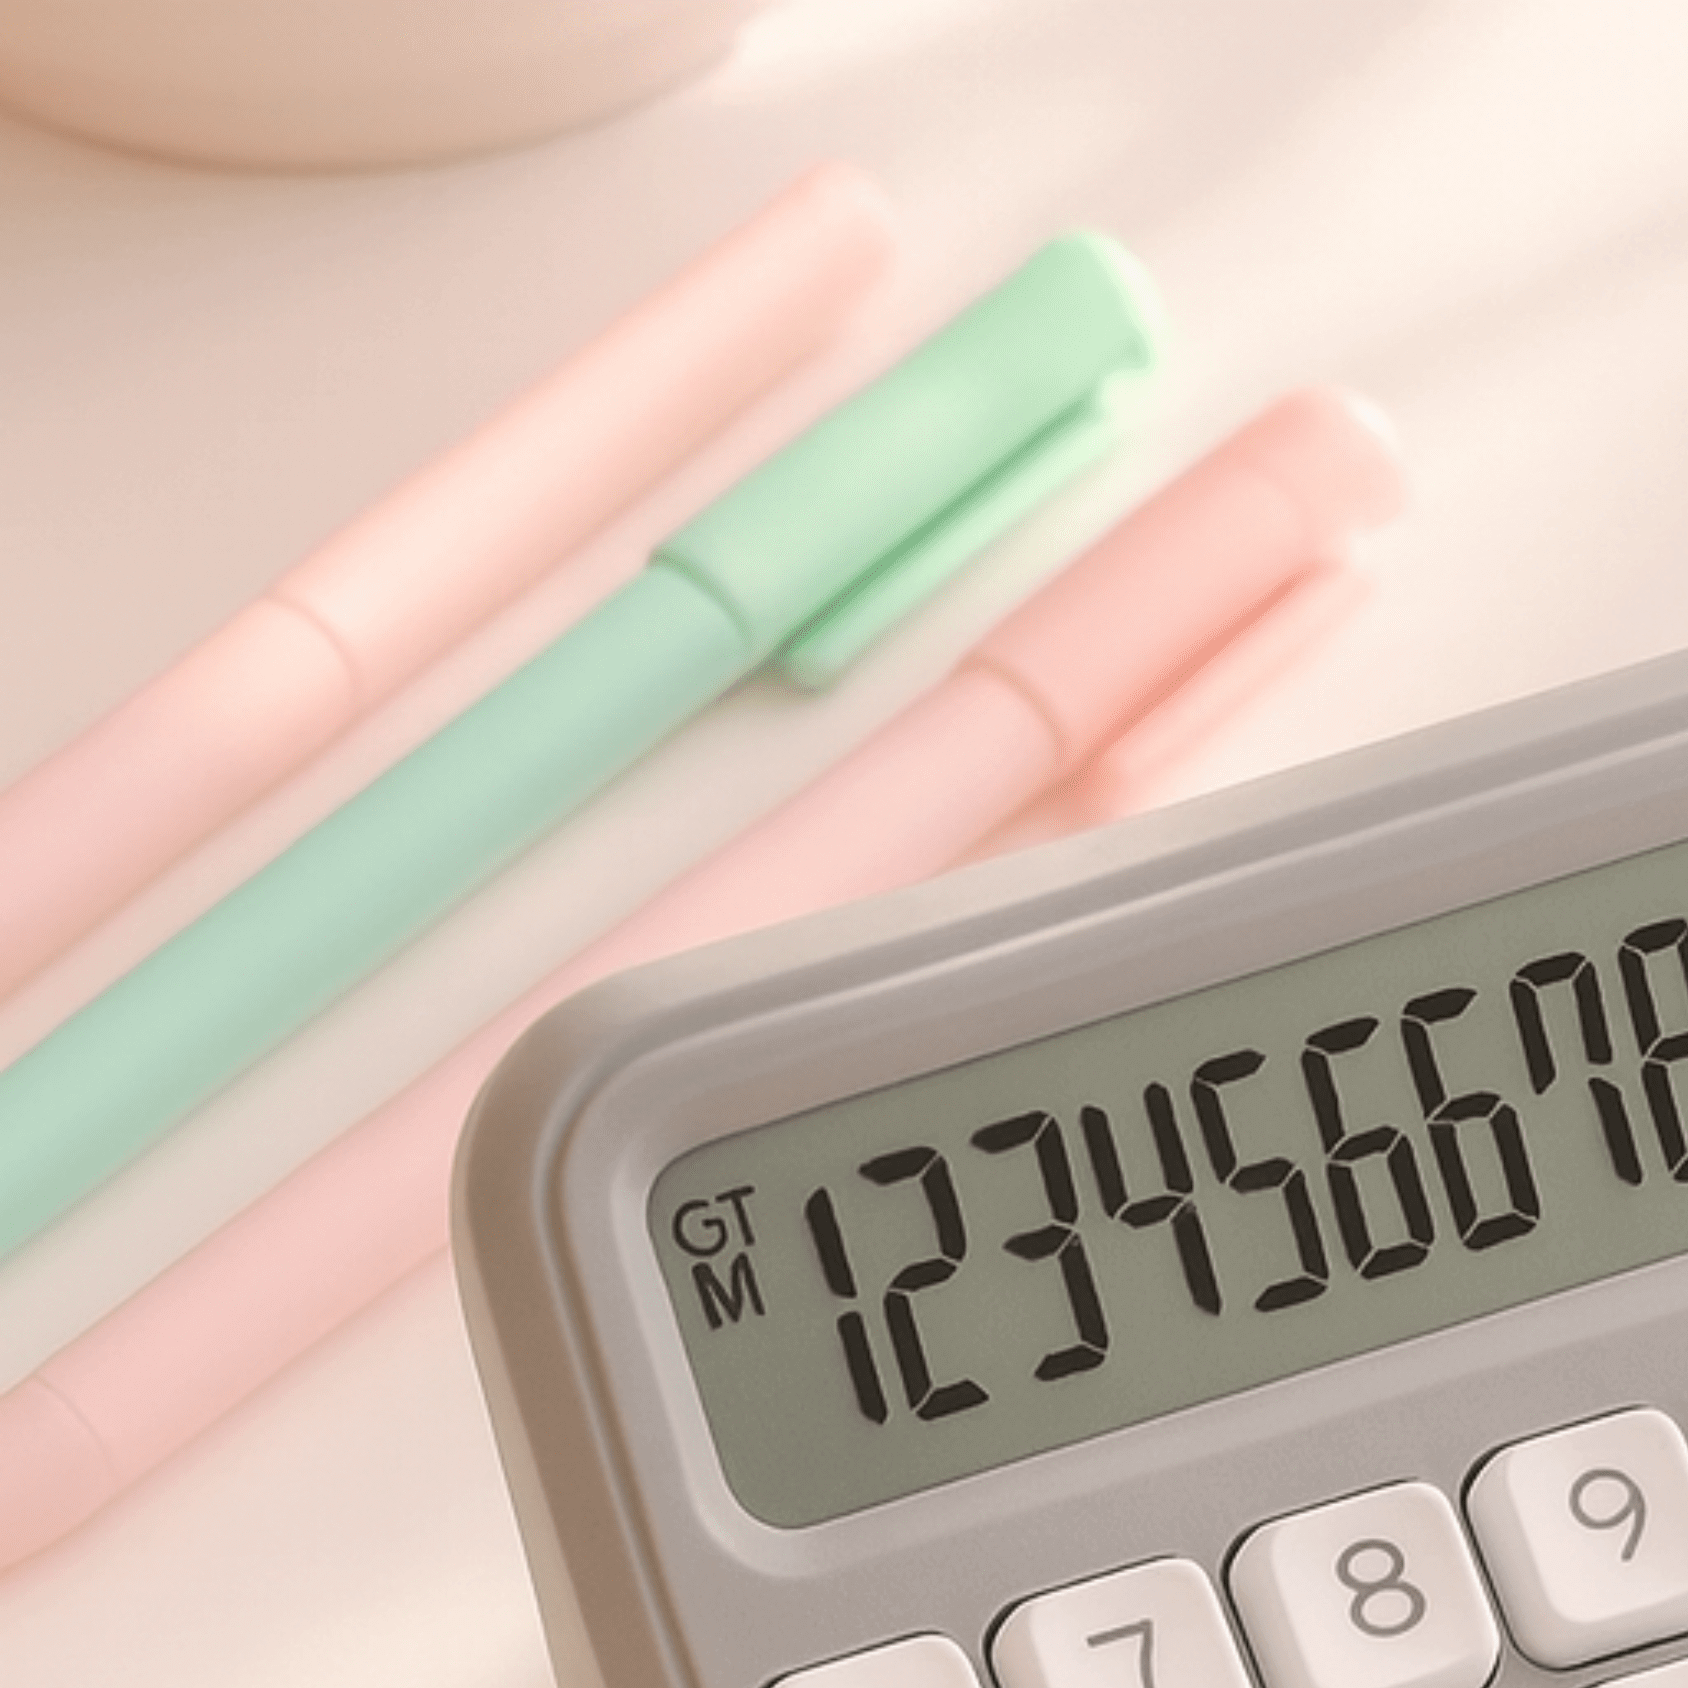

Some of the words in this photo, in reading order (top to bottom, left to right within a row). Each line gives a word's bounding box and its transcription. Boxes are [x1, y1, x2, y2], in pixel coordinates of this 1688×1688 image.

[671, 1184, 758, 1257] GT
[690, 1259, 766, 1331] M
[1568, 1467, 1648, 1563] 9
[1335, 1537, 1427, 1638] 8
